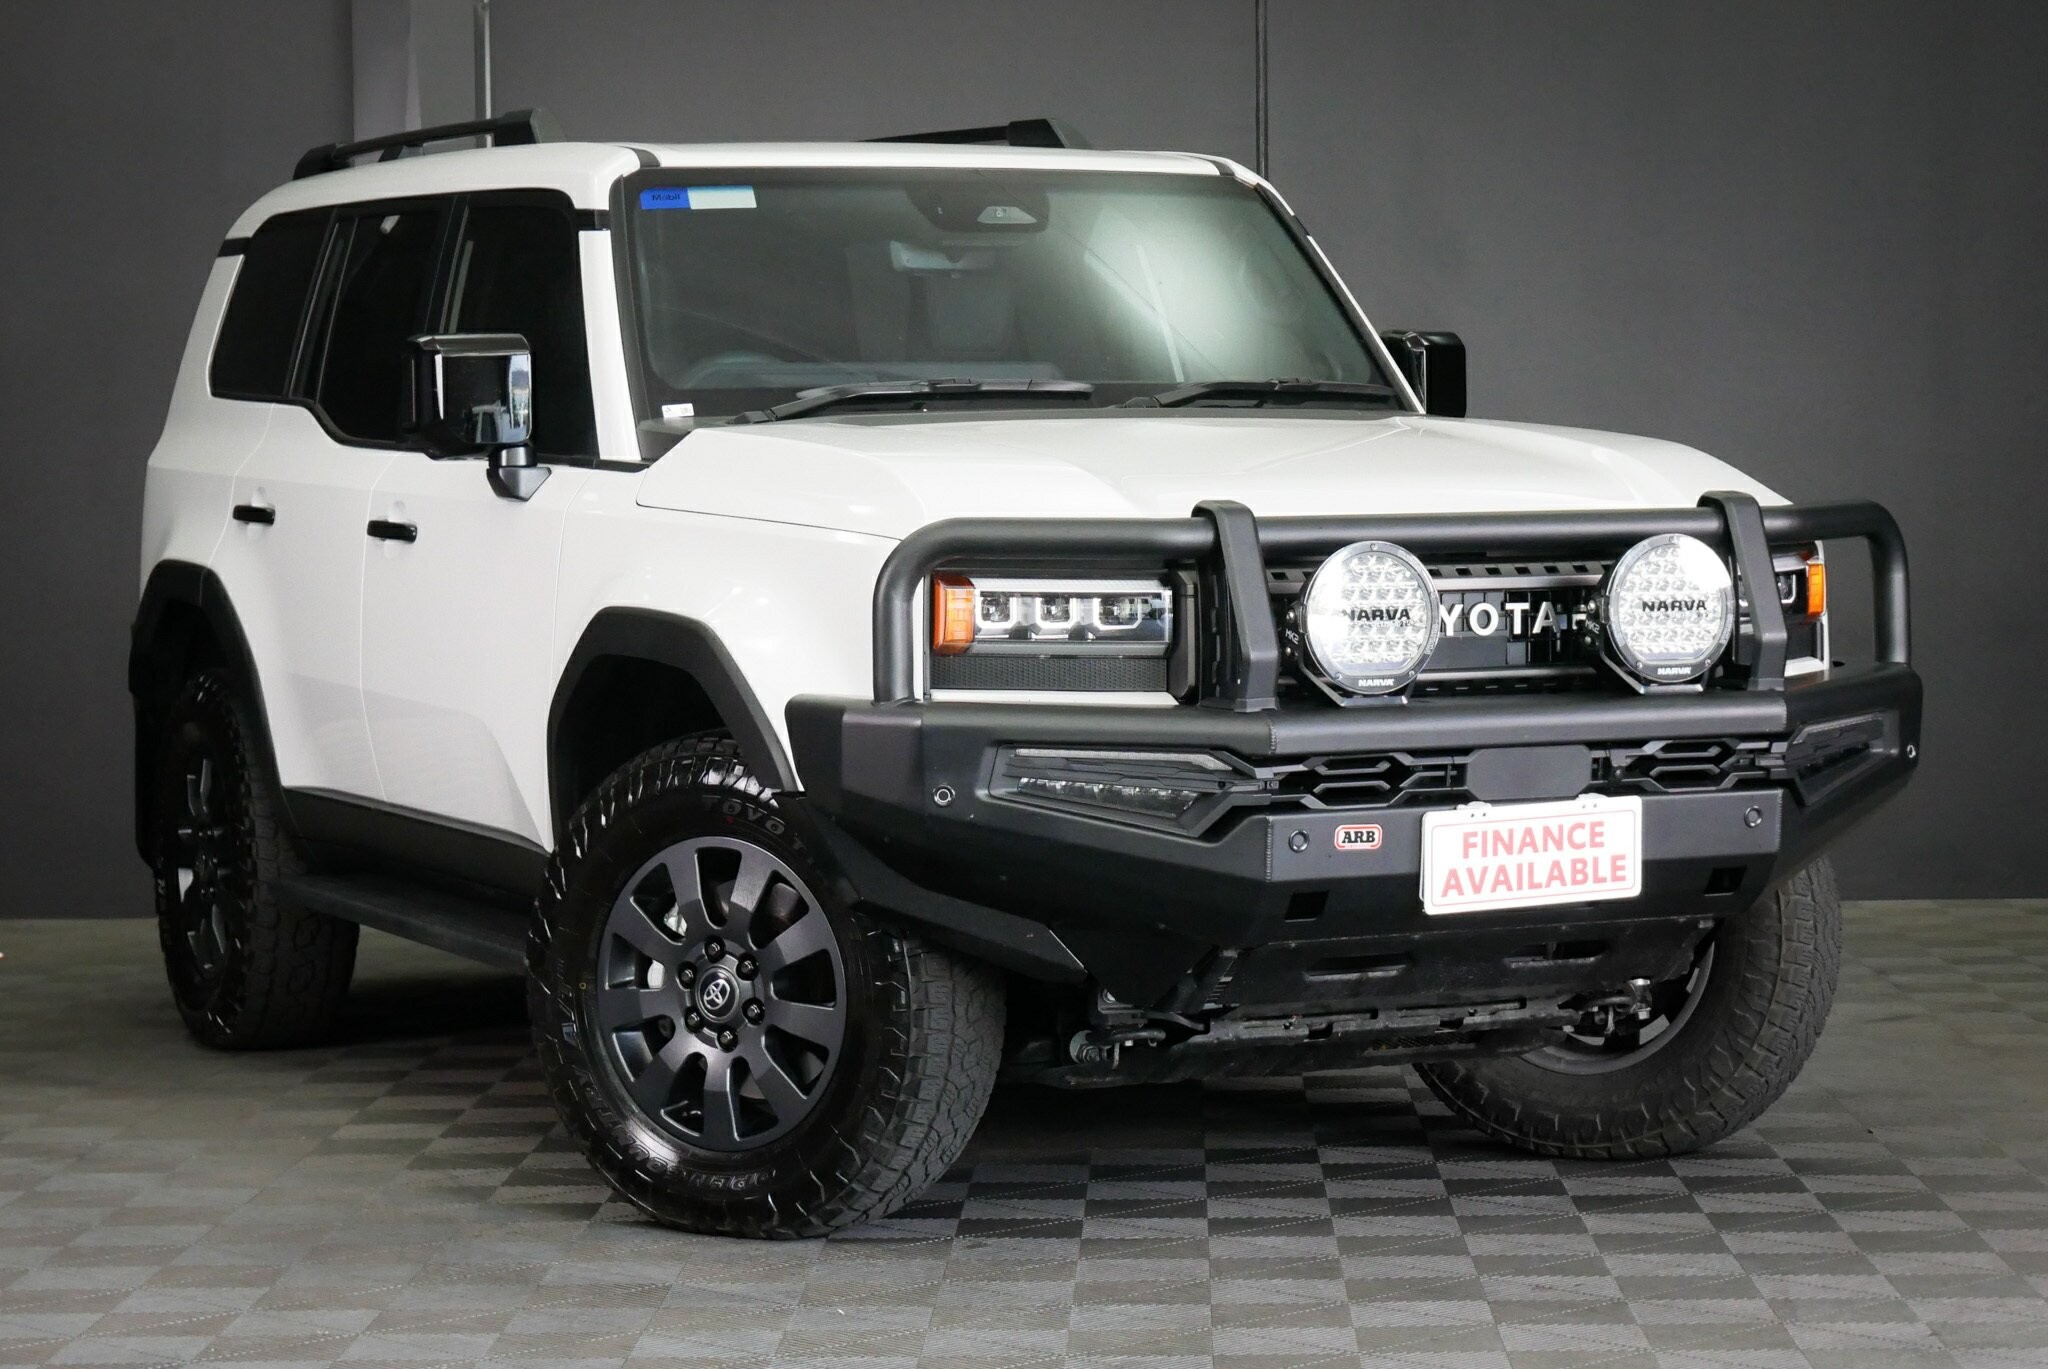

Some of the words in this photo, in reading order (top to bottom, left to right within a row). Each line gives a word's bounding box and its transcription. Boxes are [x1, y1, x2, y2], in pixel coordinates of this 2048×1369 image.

[1642, 600, 1707, 612] NARVA
[1342, 608, 1411, 621] NARVA
[1439, 602, 1558, 636] YOTA
[1657, 667, 1692, 675] NARVA
[1358, 679, 1395, 687] NARVA
[1341, 831, 1376, 843] ARB
[1462, 821, 1605, 859] FINANCE
[1441, 854, 1627, 898] AVAILABLE
